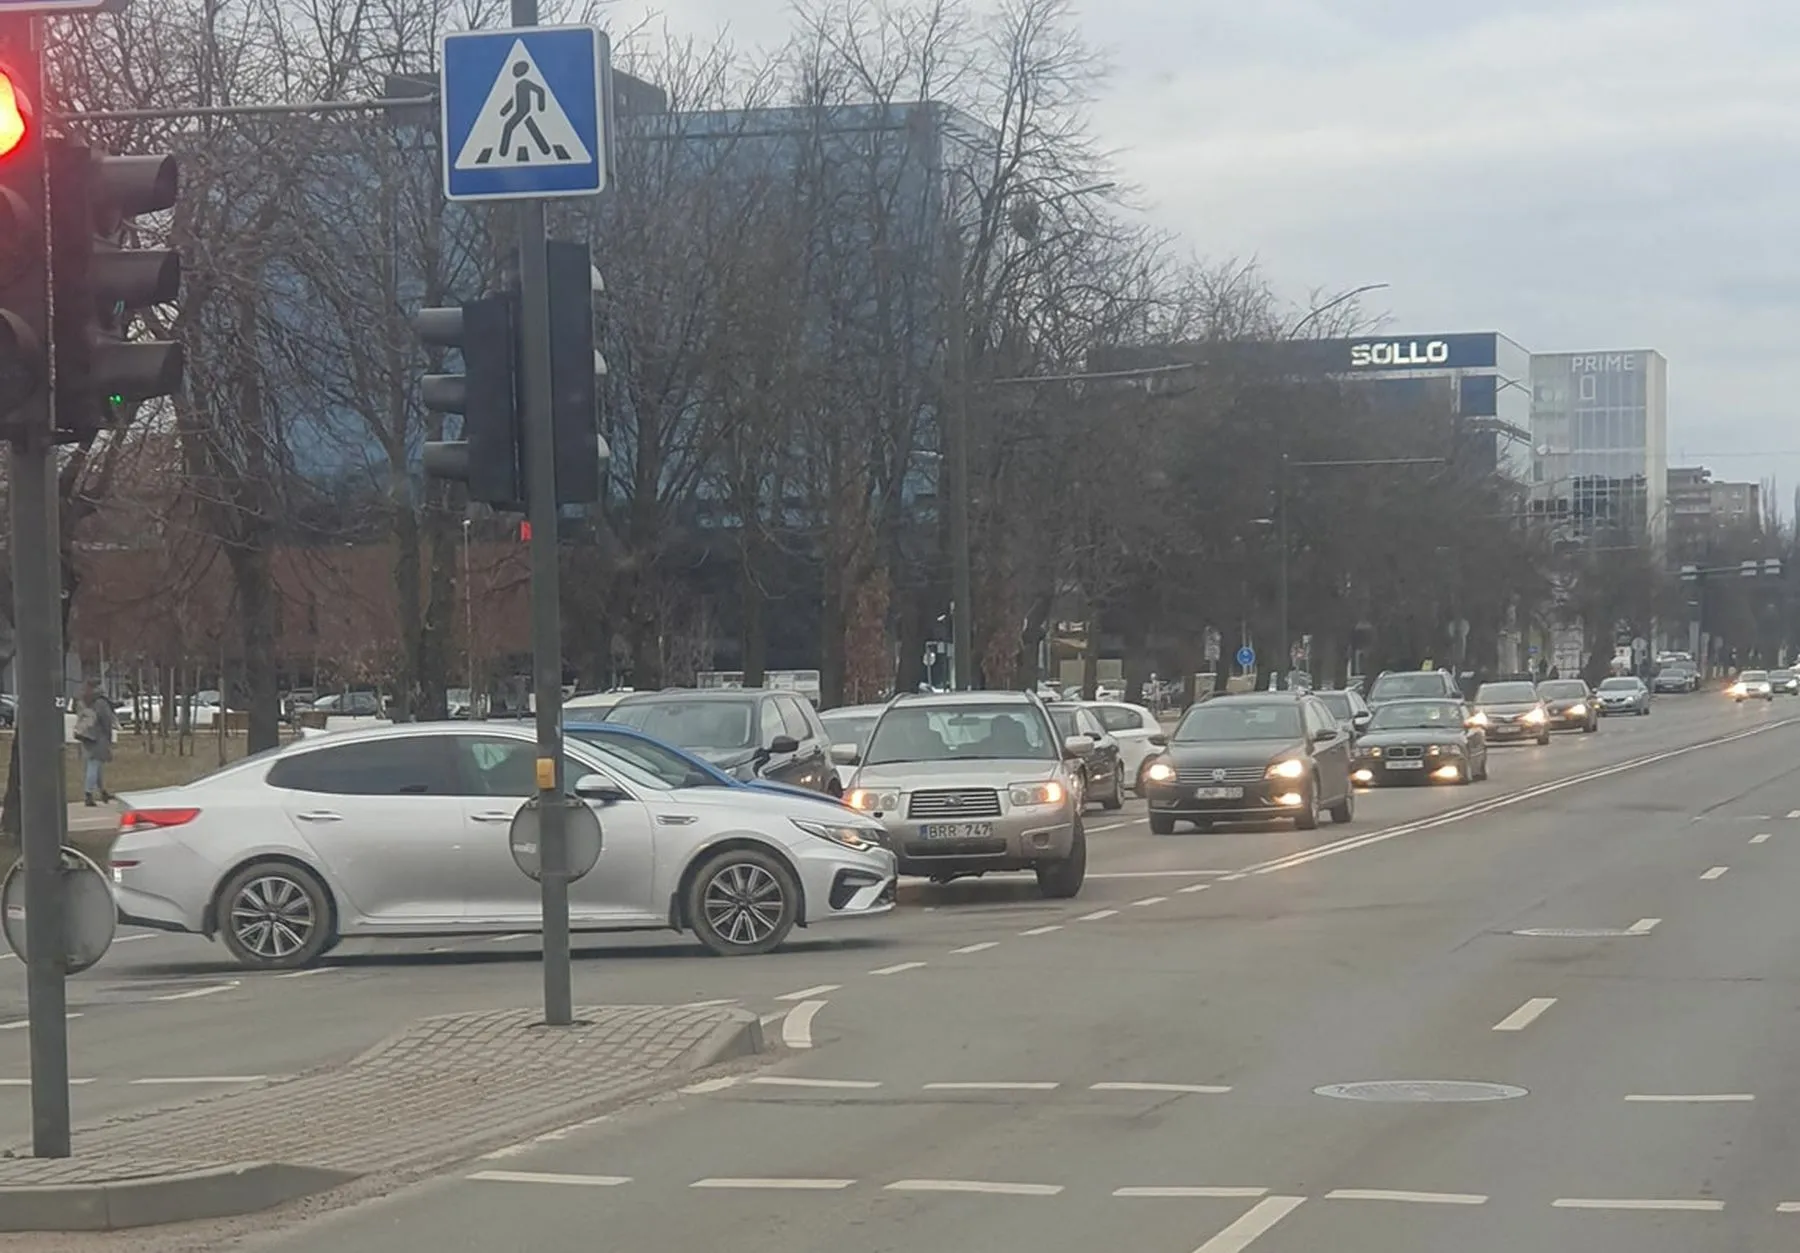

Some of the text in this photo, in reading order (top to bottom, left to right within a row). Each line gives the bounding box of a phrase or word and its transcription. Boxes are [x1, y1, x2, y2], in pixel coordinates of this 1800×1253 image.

[1351, 341, 1449, 366] SOLLO
[1572, 353, 1635, 373] PRIME
[928, 824, 990, 839] BRR 747
